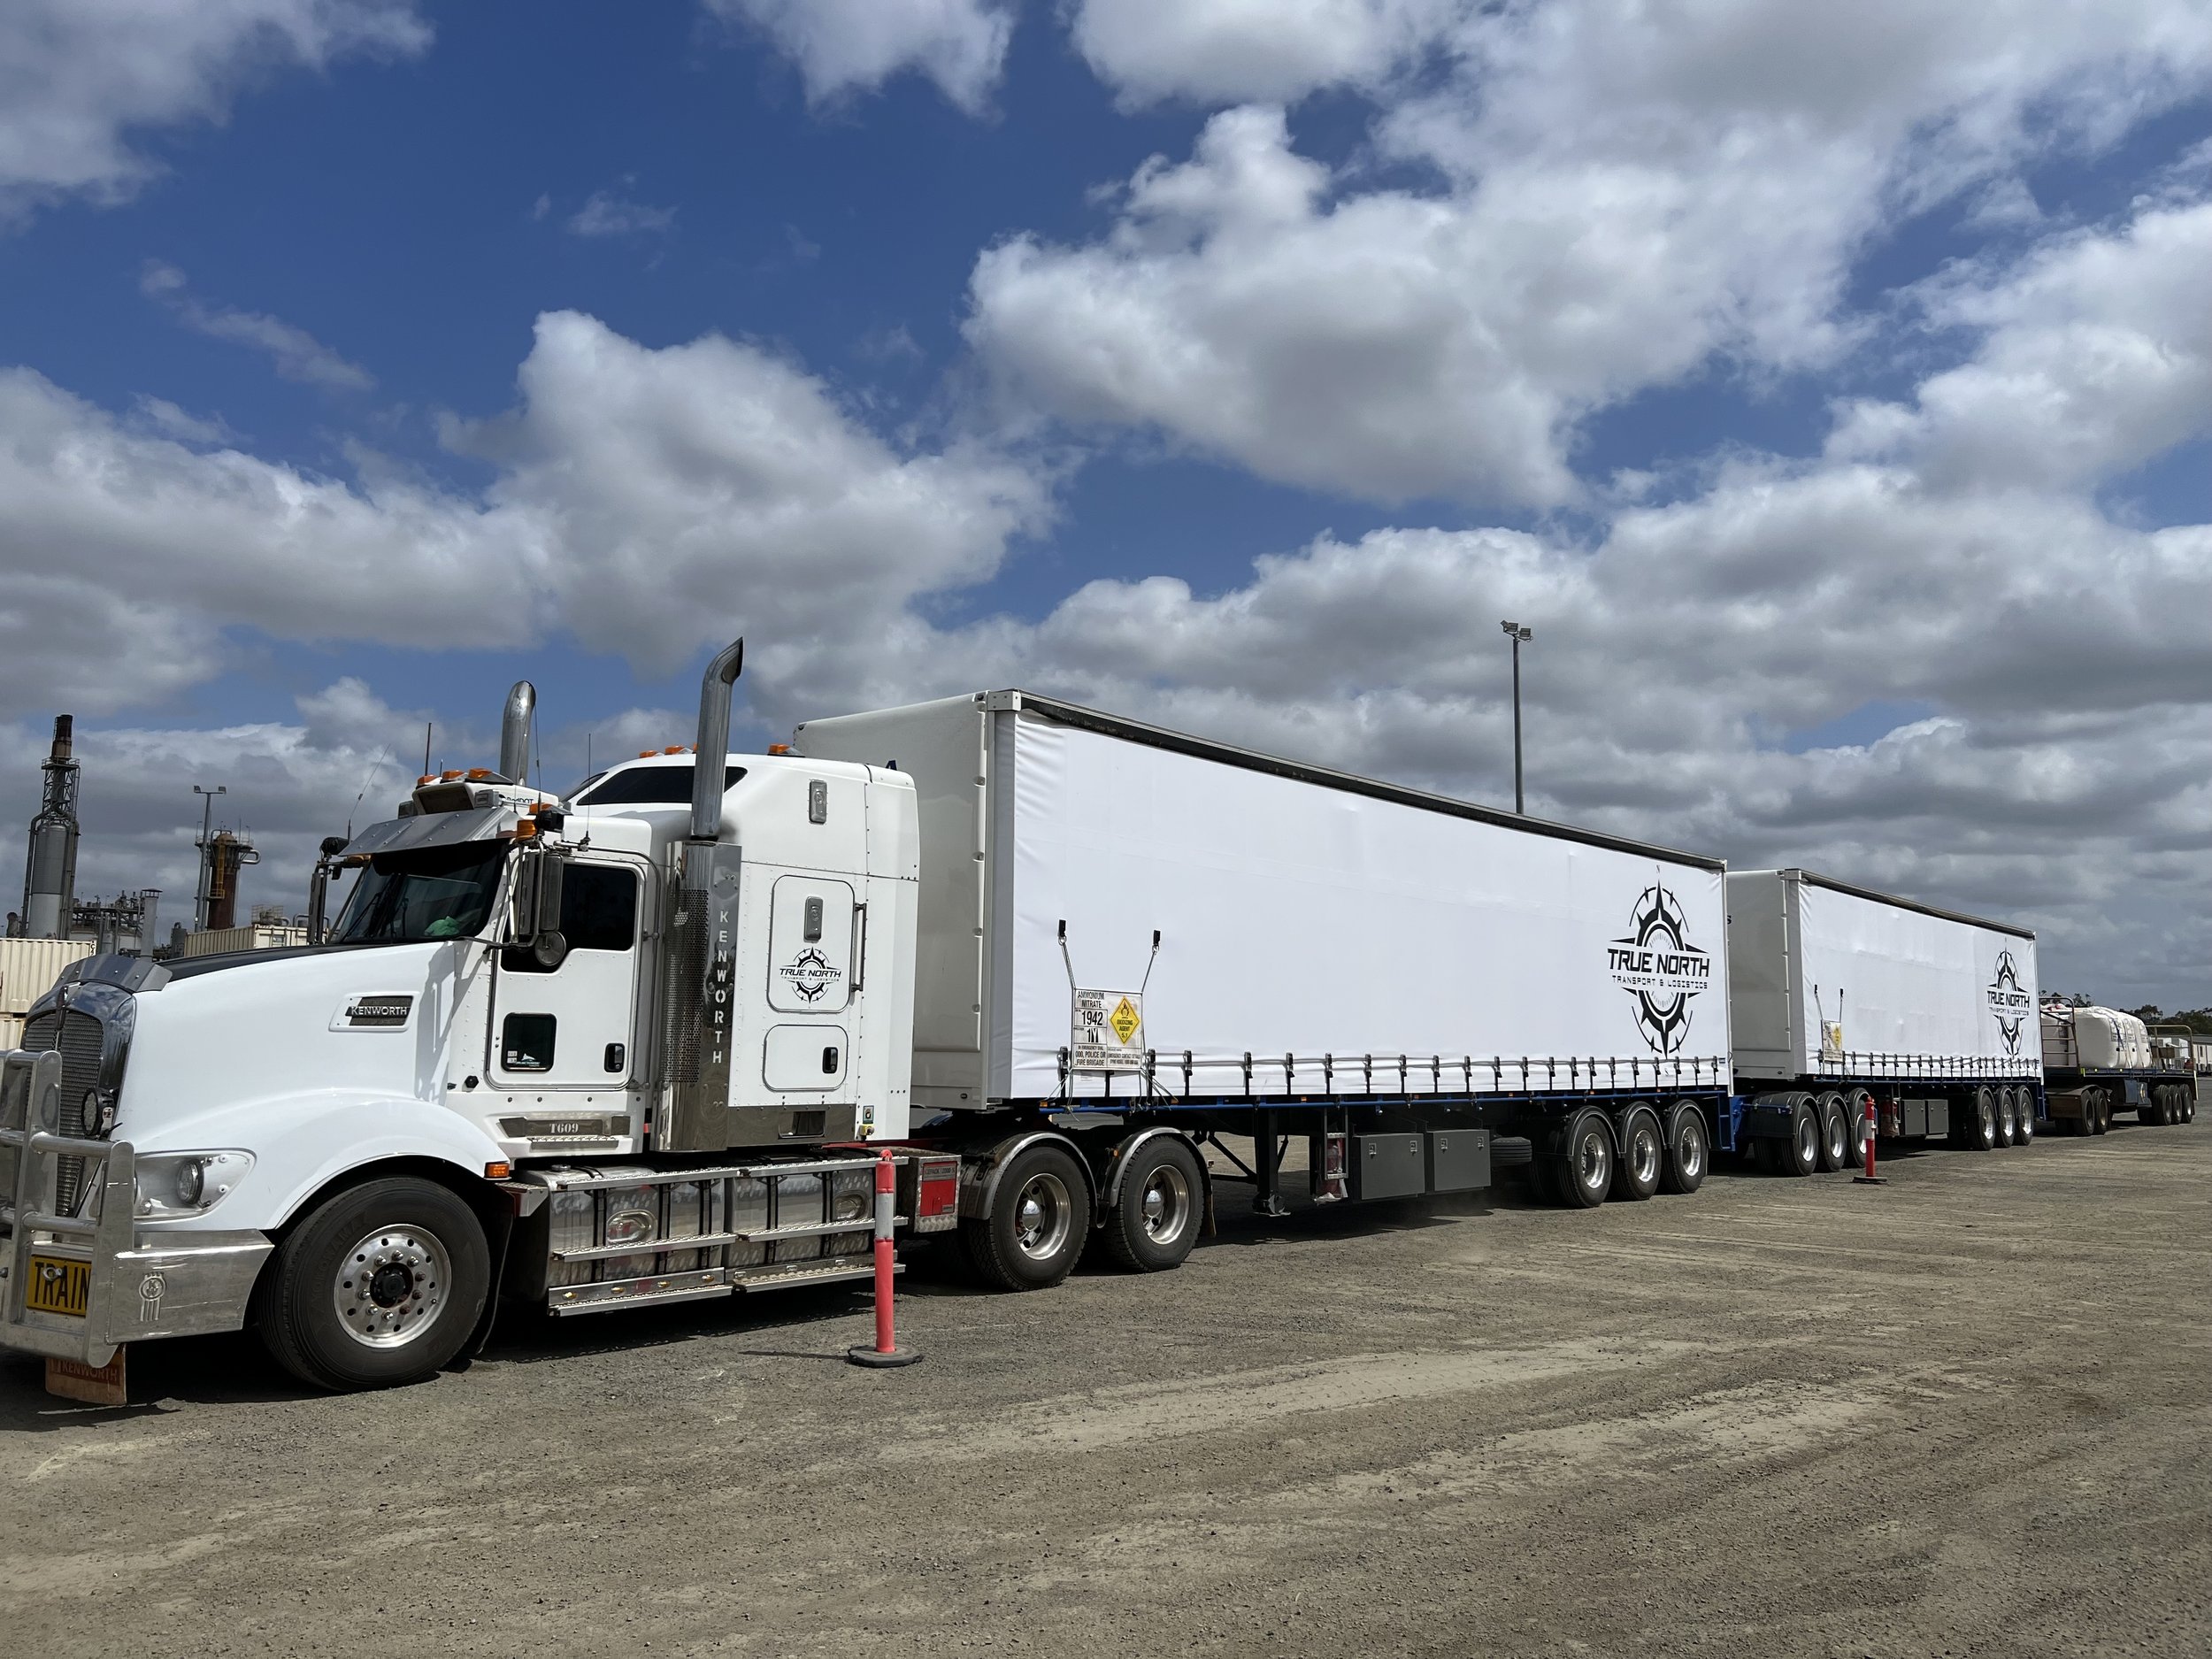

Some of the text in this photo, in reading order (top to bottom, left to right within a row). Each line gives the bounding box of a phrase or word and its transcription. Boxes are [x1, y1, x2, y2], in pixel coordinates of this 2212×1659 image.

[1607, 949, 1710, 977] TRUE NORTH
[712, 910, 729, 1064] KENWORTH
[1612, 975, 1655, 986] TRANSPORT
[1668, 979, 1708, 989] LOGISTICS
[1078, 991, 1105, 1000] AMMONIUM
[1987, 991, 2030, 1008] TRUE NORTH
[351, 1005, 407, 1016] KENWORTH
[1082, 1010, 1103, 1025] 1942
[549, 1123, 579, 1133] T609
